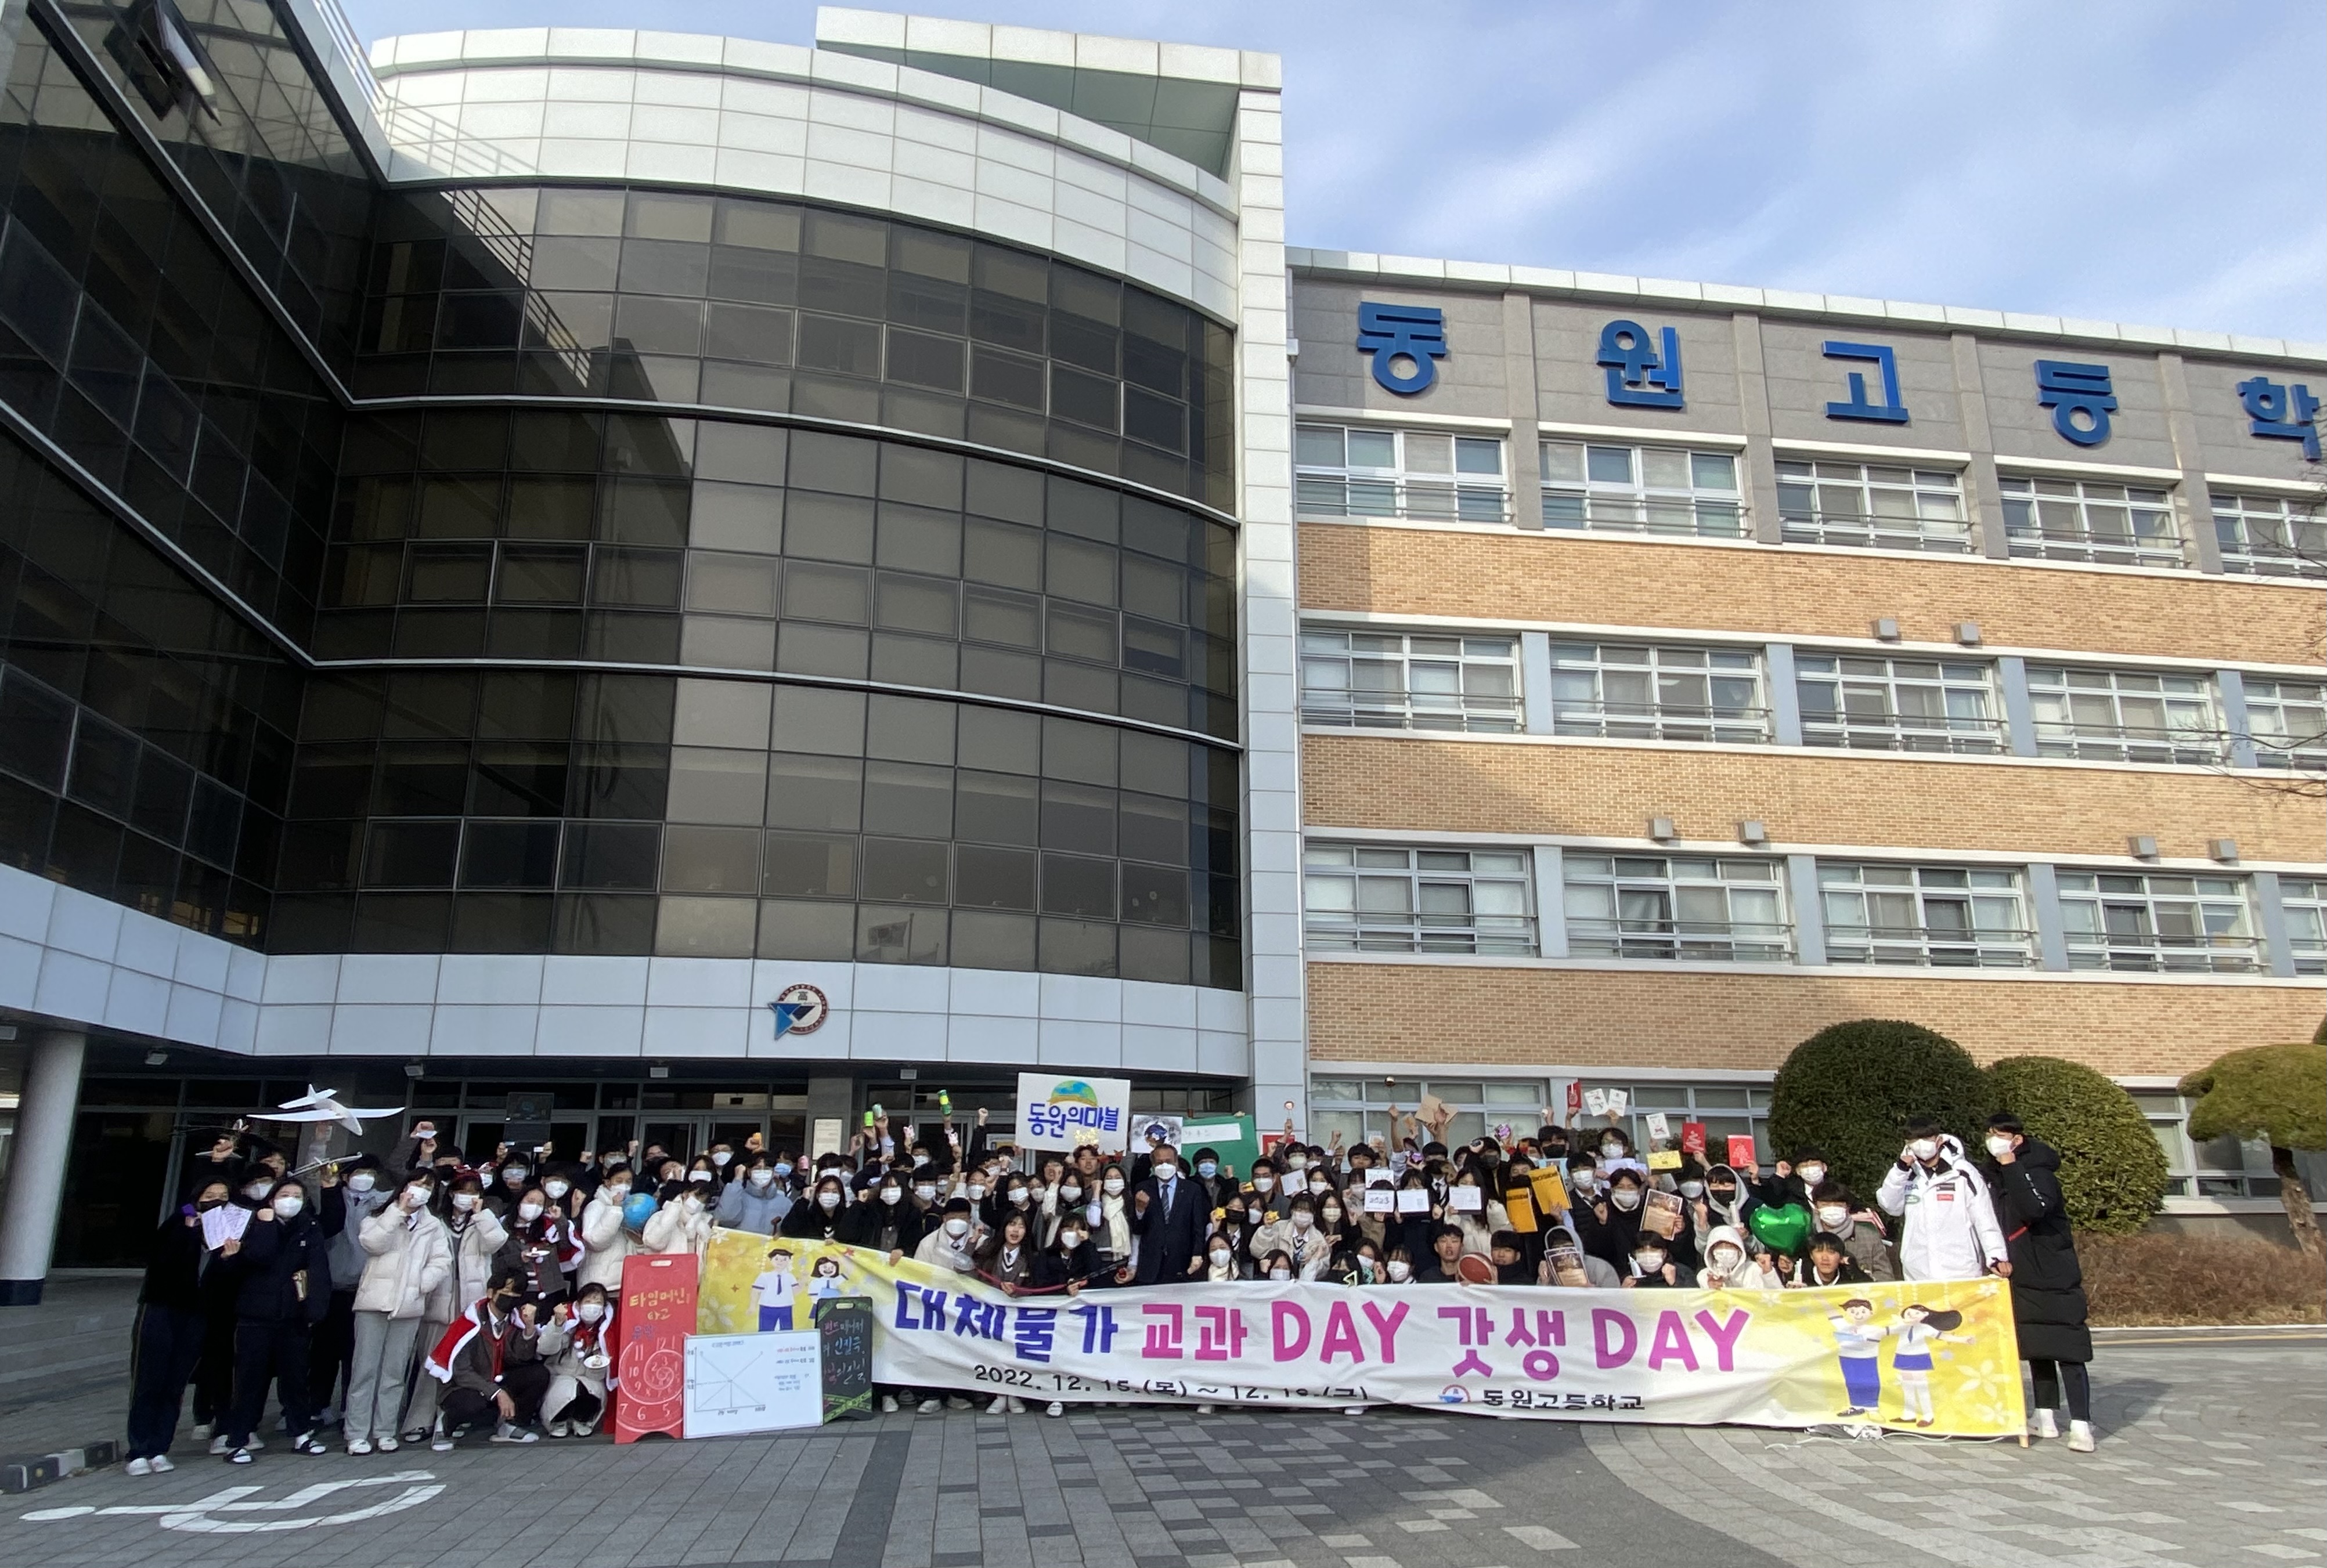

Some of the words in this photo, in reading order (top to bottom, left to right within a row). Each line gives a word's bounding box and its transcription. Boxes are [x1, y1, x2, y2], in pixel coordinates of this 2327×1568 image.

[1142, 1303, 1247, 1361] 교과
[1271, 1300, 1410, 1364] DAY
[1437, 1306, 1566, 1381] 갓생
[1590, 1307, 1750, 1372] DAY
[974, 1364, 1042, 1390] 2022.
[1052, 1374, 1091, 1392] 12.
[619, 1403, 629, 1415] 7
[1482, 1389, 1646, 1411] 동원고등학교
[637, 1406, 647, 1421] 6
